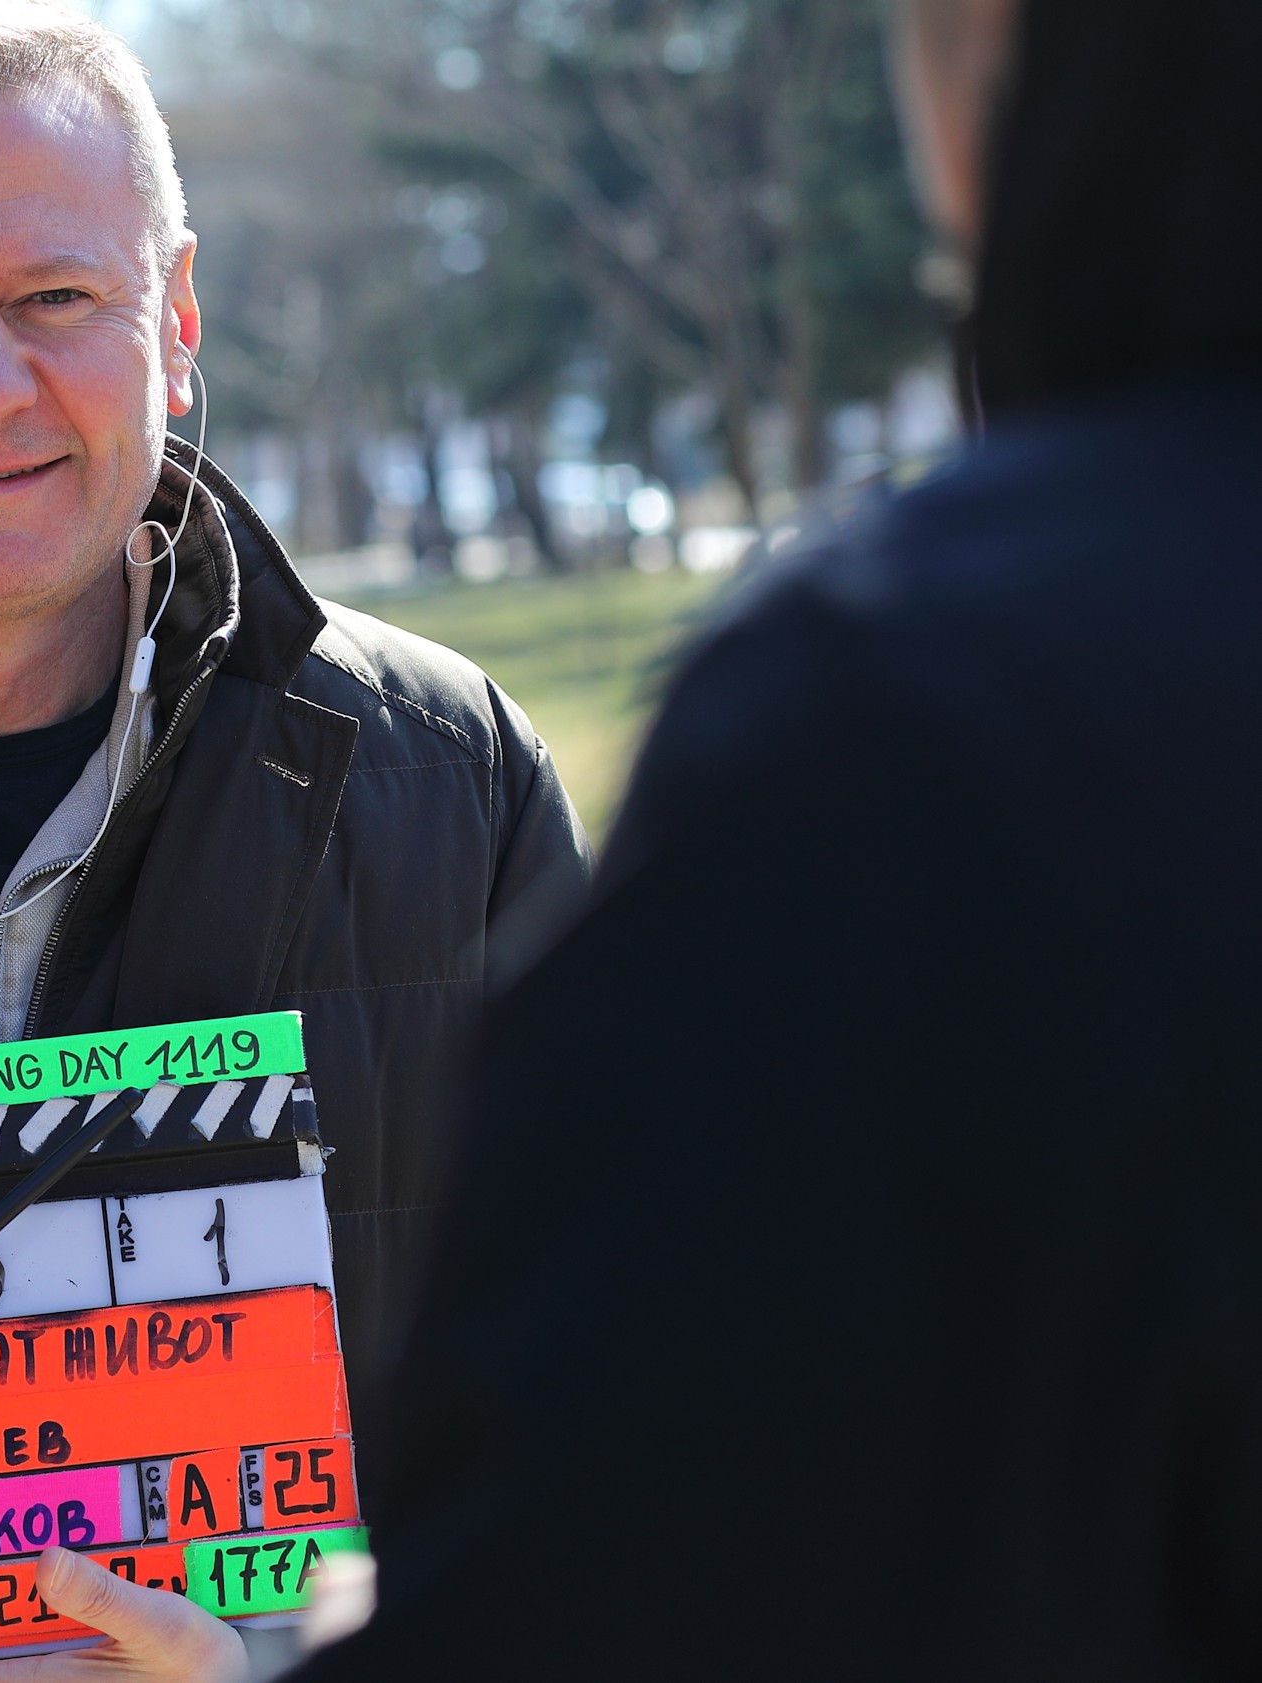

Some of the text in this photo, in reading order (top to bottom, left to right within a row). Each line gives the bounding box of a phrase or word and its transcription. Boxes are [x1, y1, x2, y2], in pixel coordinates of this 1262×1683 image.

[59, 1041, 129, 1088] DAY
[144, 1030, 261, 1080] 1119
[203, 1198, 230, 1286] 1
[63, 1311, 247, 1383] ЖИВОТ
[145, 1466, 166, 1521] CAM
[180, 1463, 217, 1531] A
[245, 1454, 263, 1507] FPS
[274, 1448, 336, 1516] 25
